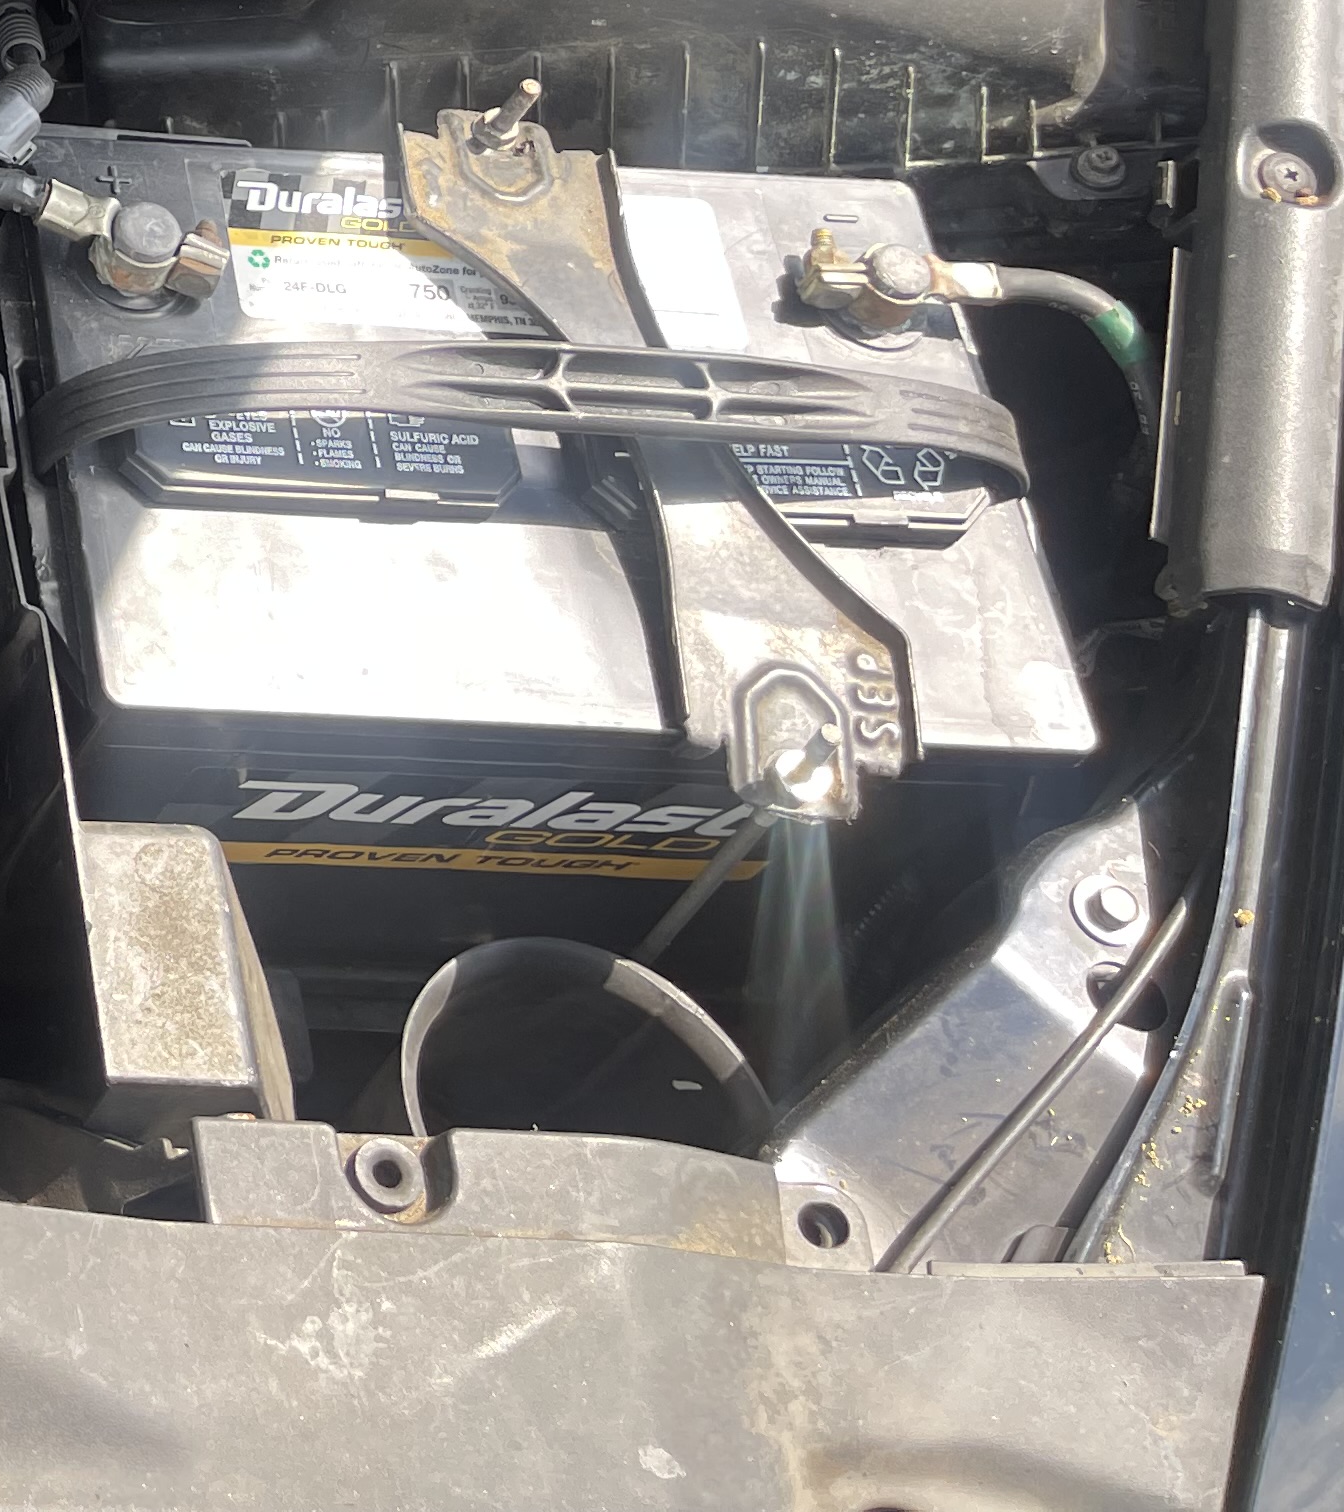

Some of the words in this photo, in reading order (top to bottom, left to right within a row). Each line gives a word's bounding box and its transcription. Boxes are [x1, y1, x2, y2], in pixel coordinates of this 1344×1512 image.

[236, 180, 404, 219] Duralas
[340, 215, 417, 233] GOLD
[270, 234, 340, 246] PROVEN
[347, 239, 403, 251] TOUGH
[283, 281, 347, 294] 24F-DLG
[409, 284, 450, 301] 750
[209, 419, 276, 433] EXPLOSIVE
[322, 427, 341, 438] NO
[211, 431, 254, 443] GASES
[389, 431, 450, 444] SULFURIC
[451, 434, 479, 445] ACID
[182, 442, 202, 453] CAN
[203, 444, 235, 454] CAUSE
[235, 445, 285, 456] BLINDNESS
[316, 440, 353, 449] SPARKS
[392, 443, 412, 451] CAN
[415, 443, 446, 454] CAUSE
[759, 444, 790, 457] FAST
[214, 454, 229, 463] OR
[229, 454, 262, 465] INJURY
[318, 449, 354, 459] FLAMES
[395, 452, 444, 464] BLINDNESS
[756, 465, 803, 476] STARTING
[805, 465, 845, 476] FOLLOW
[231, 779, 753, 837] Duralast
[483, 830, 722, 852] GOLD
[265, 847, 461, 864] PROVEN
[476, 854, 632, 872] TOUGH
